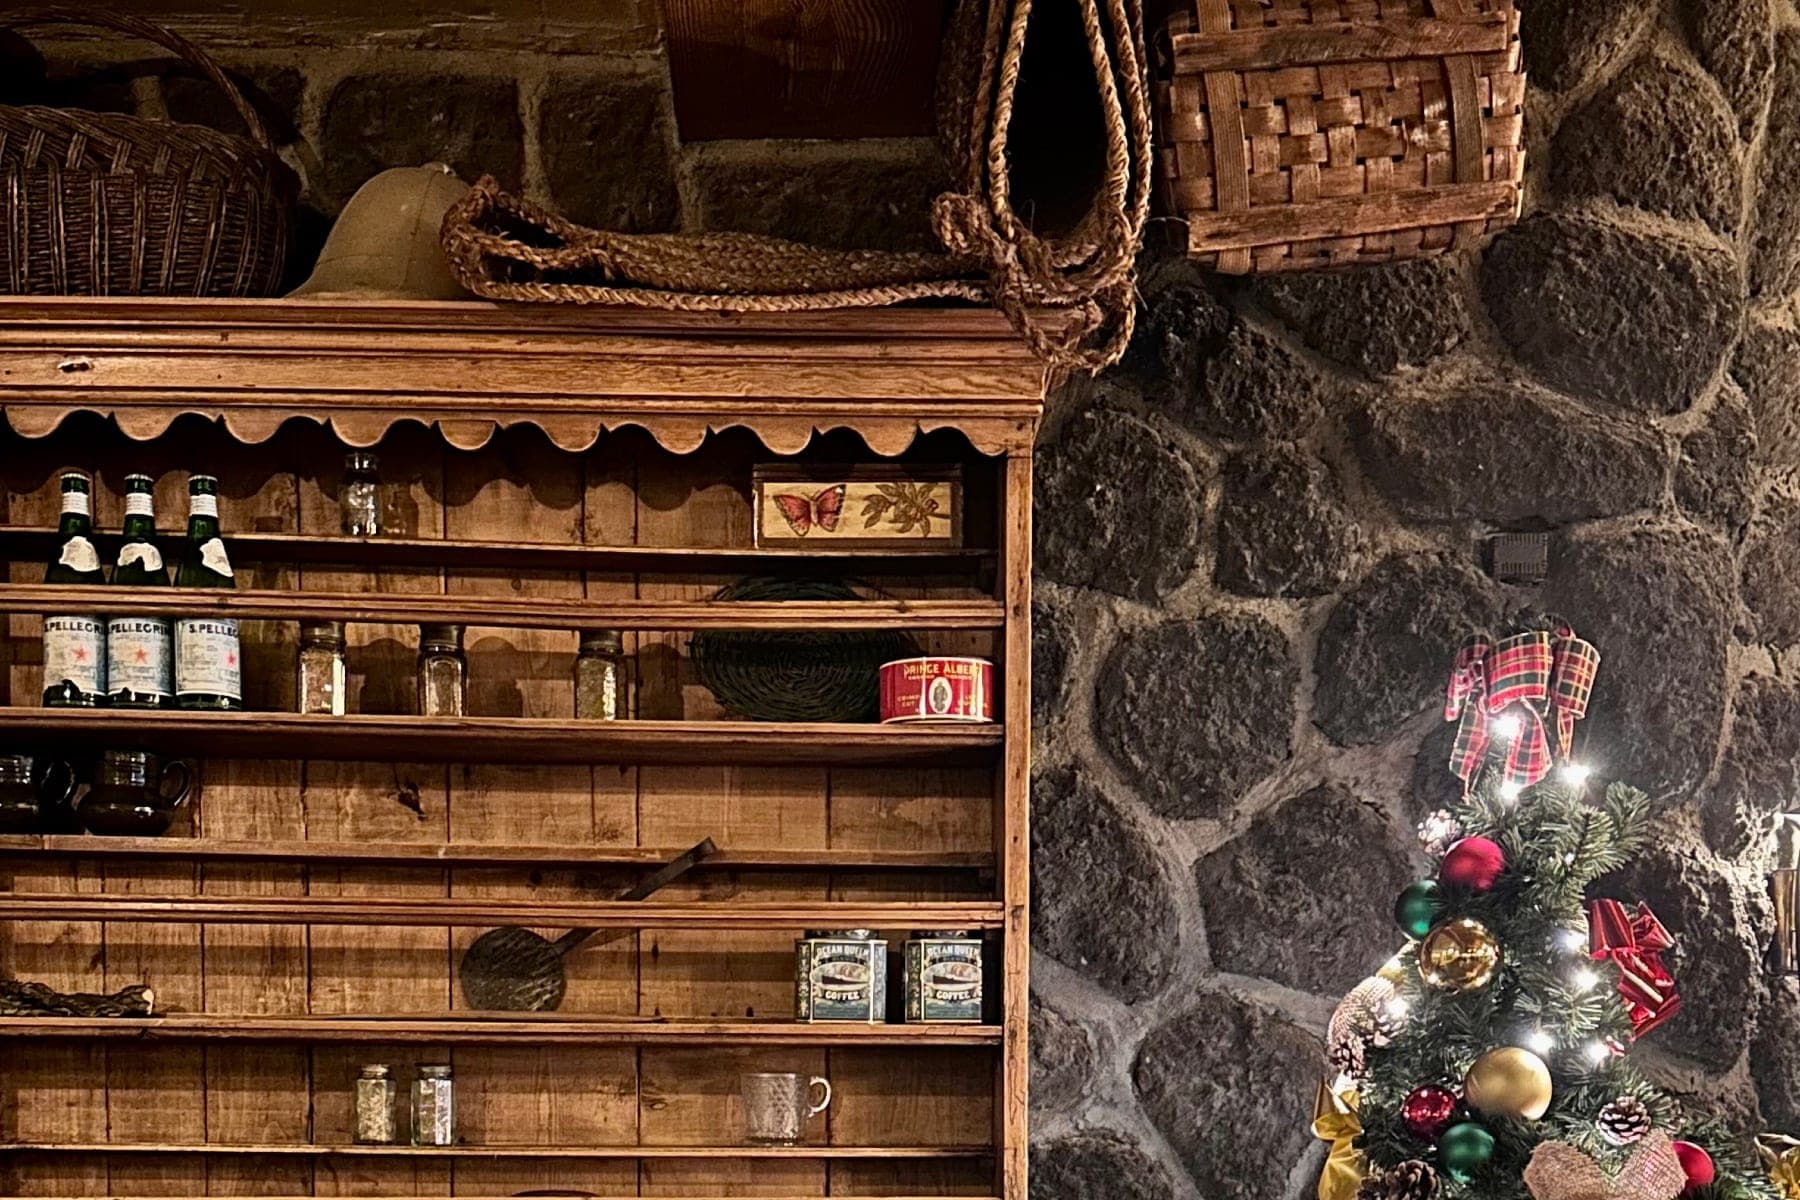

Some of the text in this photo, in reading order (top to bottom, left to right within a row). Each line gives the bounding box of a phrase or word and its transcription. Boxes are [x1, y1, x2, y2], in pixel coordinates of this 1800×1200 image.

[816, 945, 842, 956] OCEAN
[825, 990, 860, 1001] COFFEE
[936, 990, 971, 1001] COFFEE
